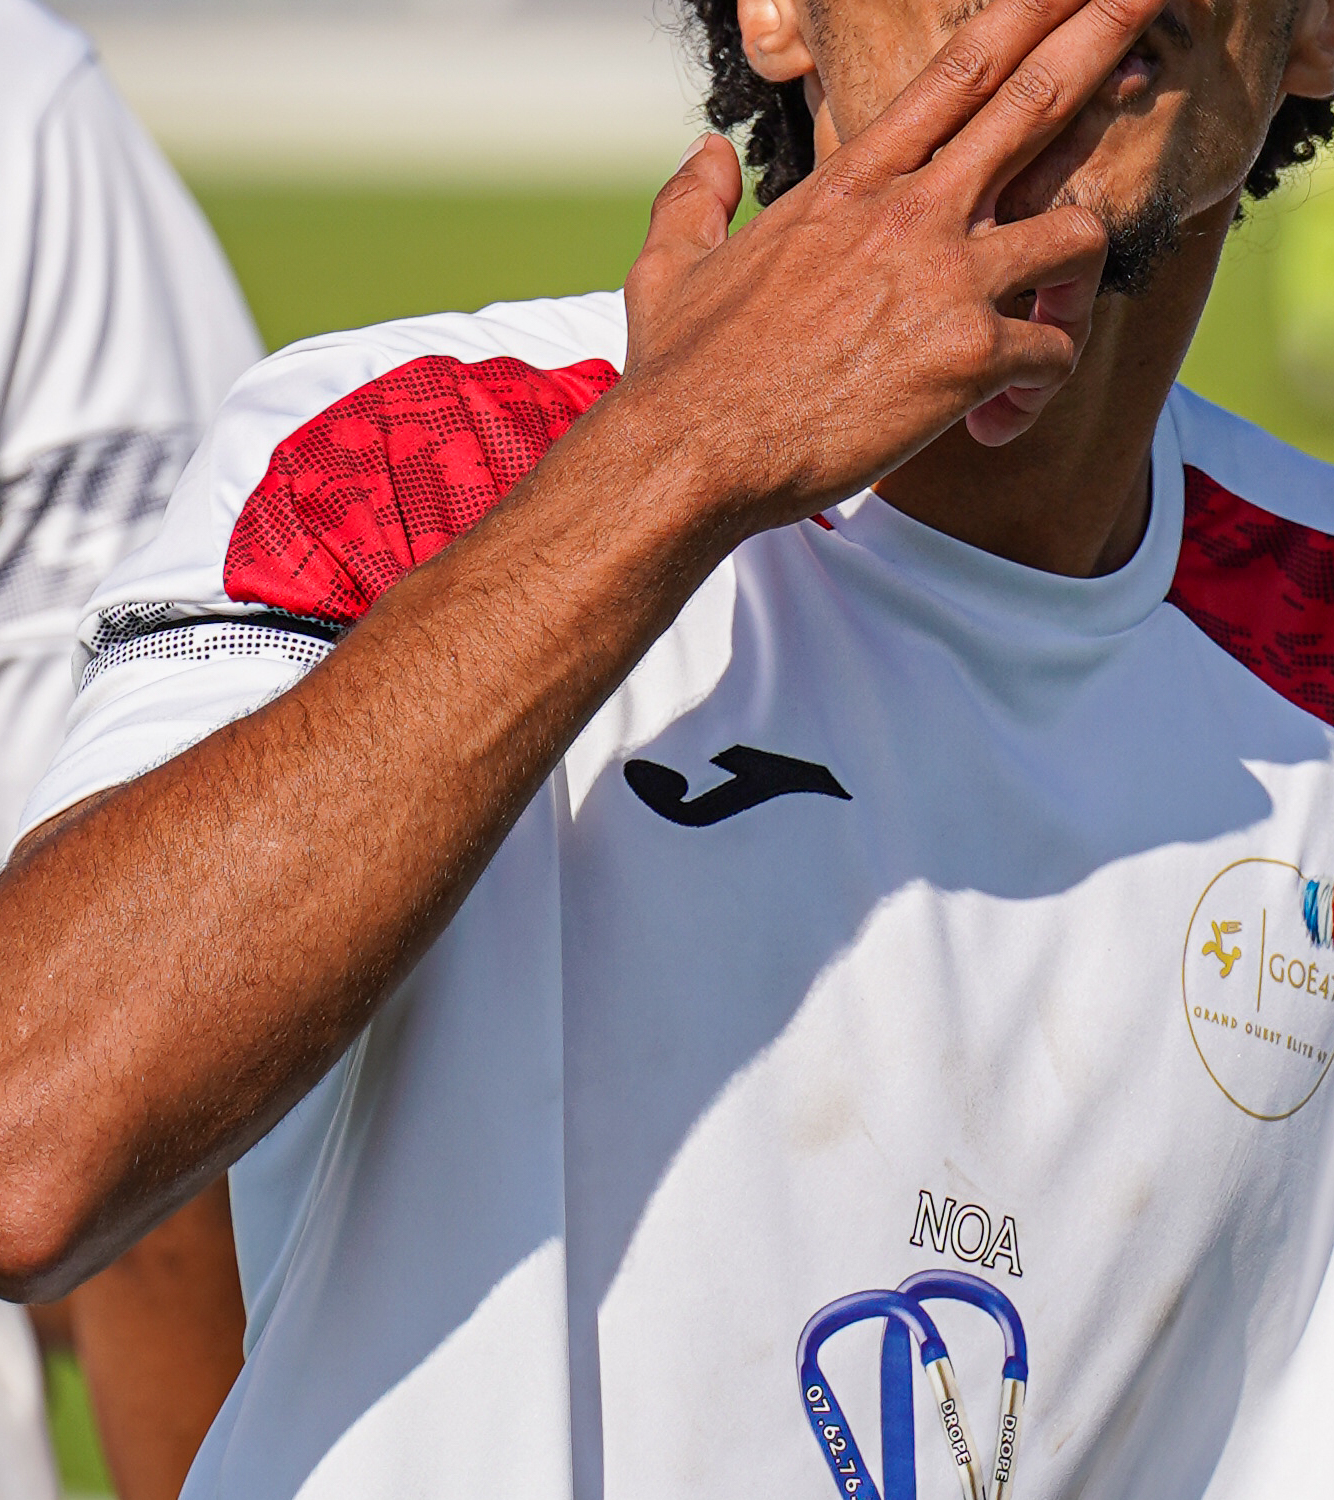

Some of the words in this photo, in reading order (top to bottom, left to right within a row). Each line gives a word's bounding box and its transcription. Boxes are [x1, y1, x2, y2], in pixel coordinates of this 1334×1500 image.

[1193, 1006, 1238, 1029] GRAND
[1245, 1021, 1282, 1045] OUEST
[909, 1189, 1023, 1278] NOA
[940, 1397, 972, 1466] DROPE
[994, 1414, 1018, 1483] DROPE
